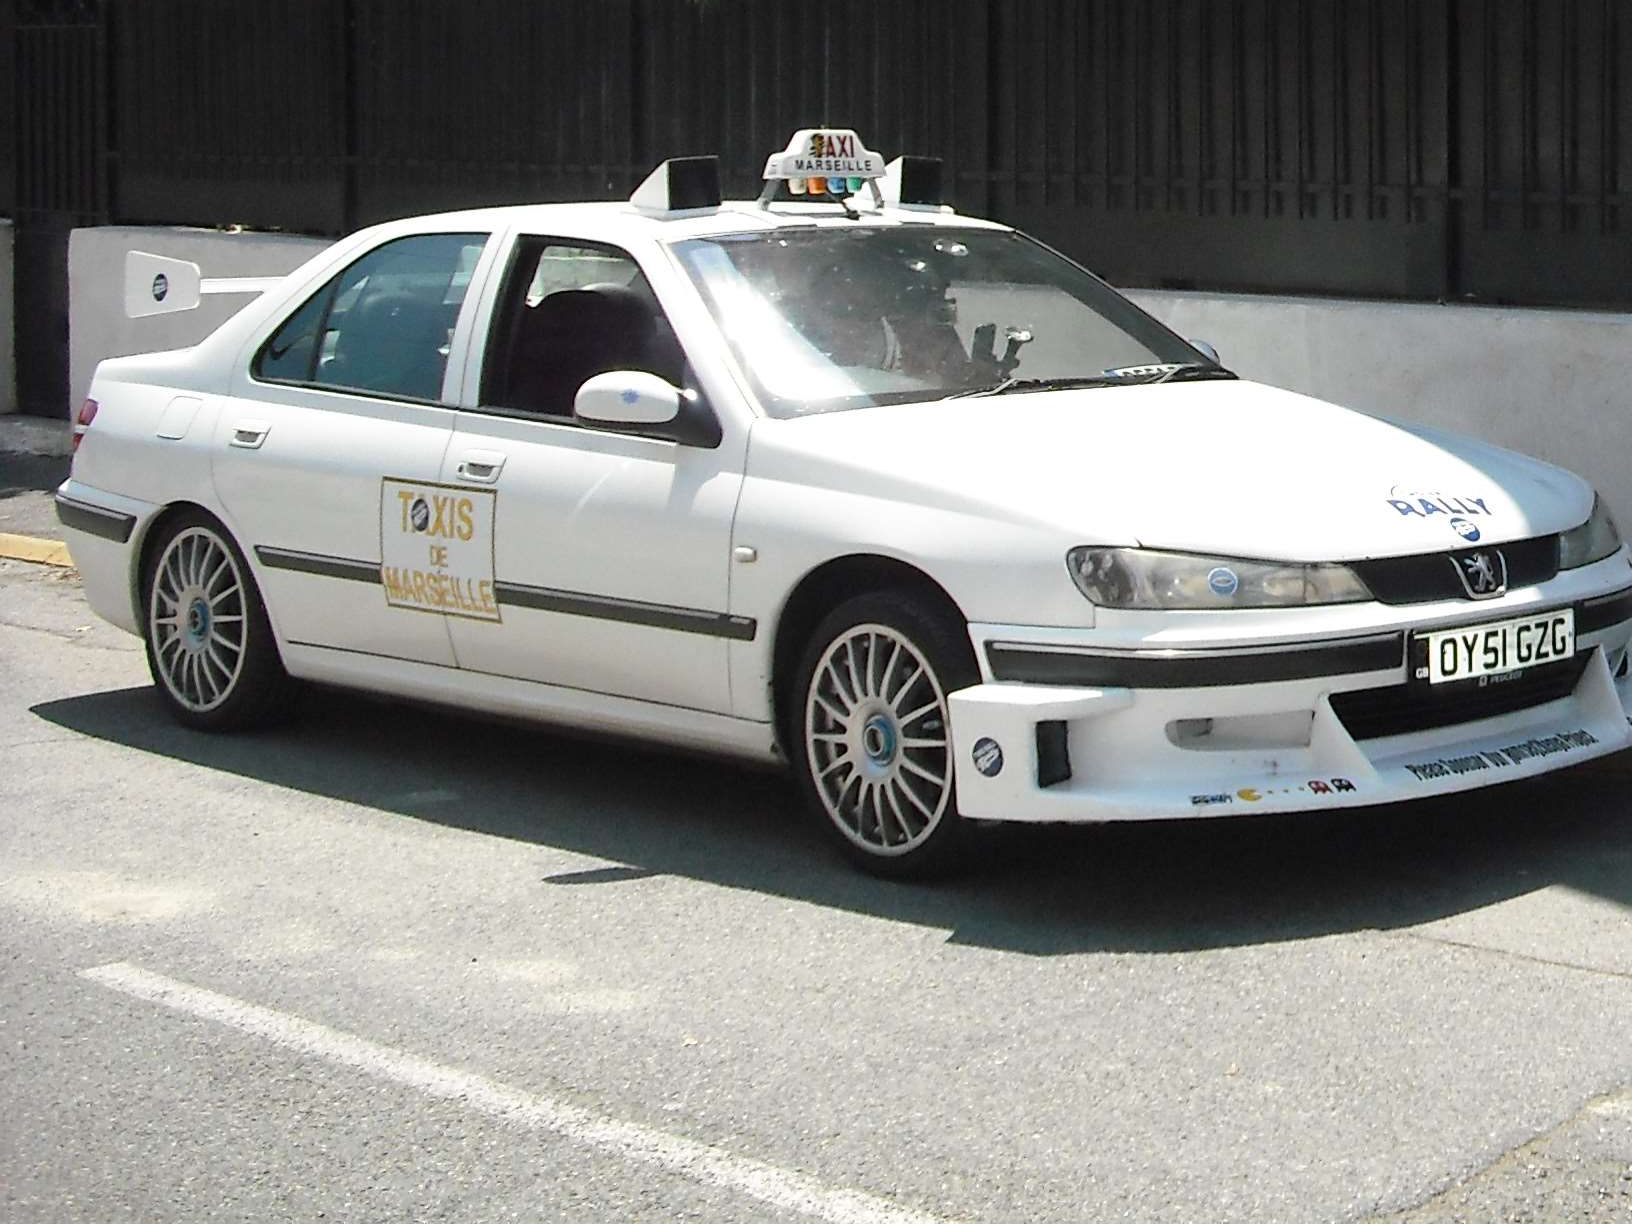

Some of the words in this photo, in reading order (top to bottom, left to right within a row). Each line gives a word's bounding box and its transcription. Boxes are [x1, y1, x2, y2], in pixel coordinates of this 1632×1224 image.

[795, 159, 872, 172] MARSEILLE
[398, 491, 474, 542] TXIS
[1386, 497, 1492, 517] RALLY
[430, 544, 449, 568] DE
[383, 566, 497, 614] MARSEILLE
[1440, 628, 1507, 676] OY51
[1516, 618, 1567, 664] GZG
